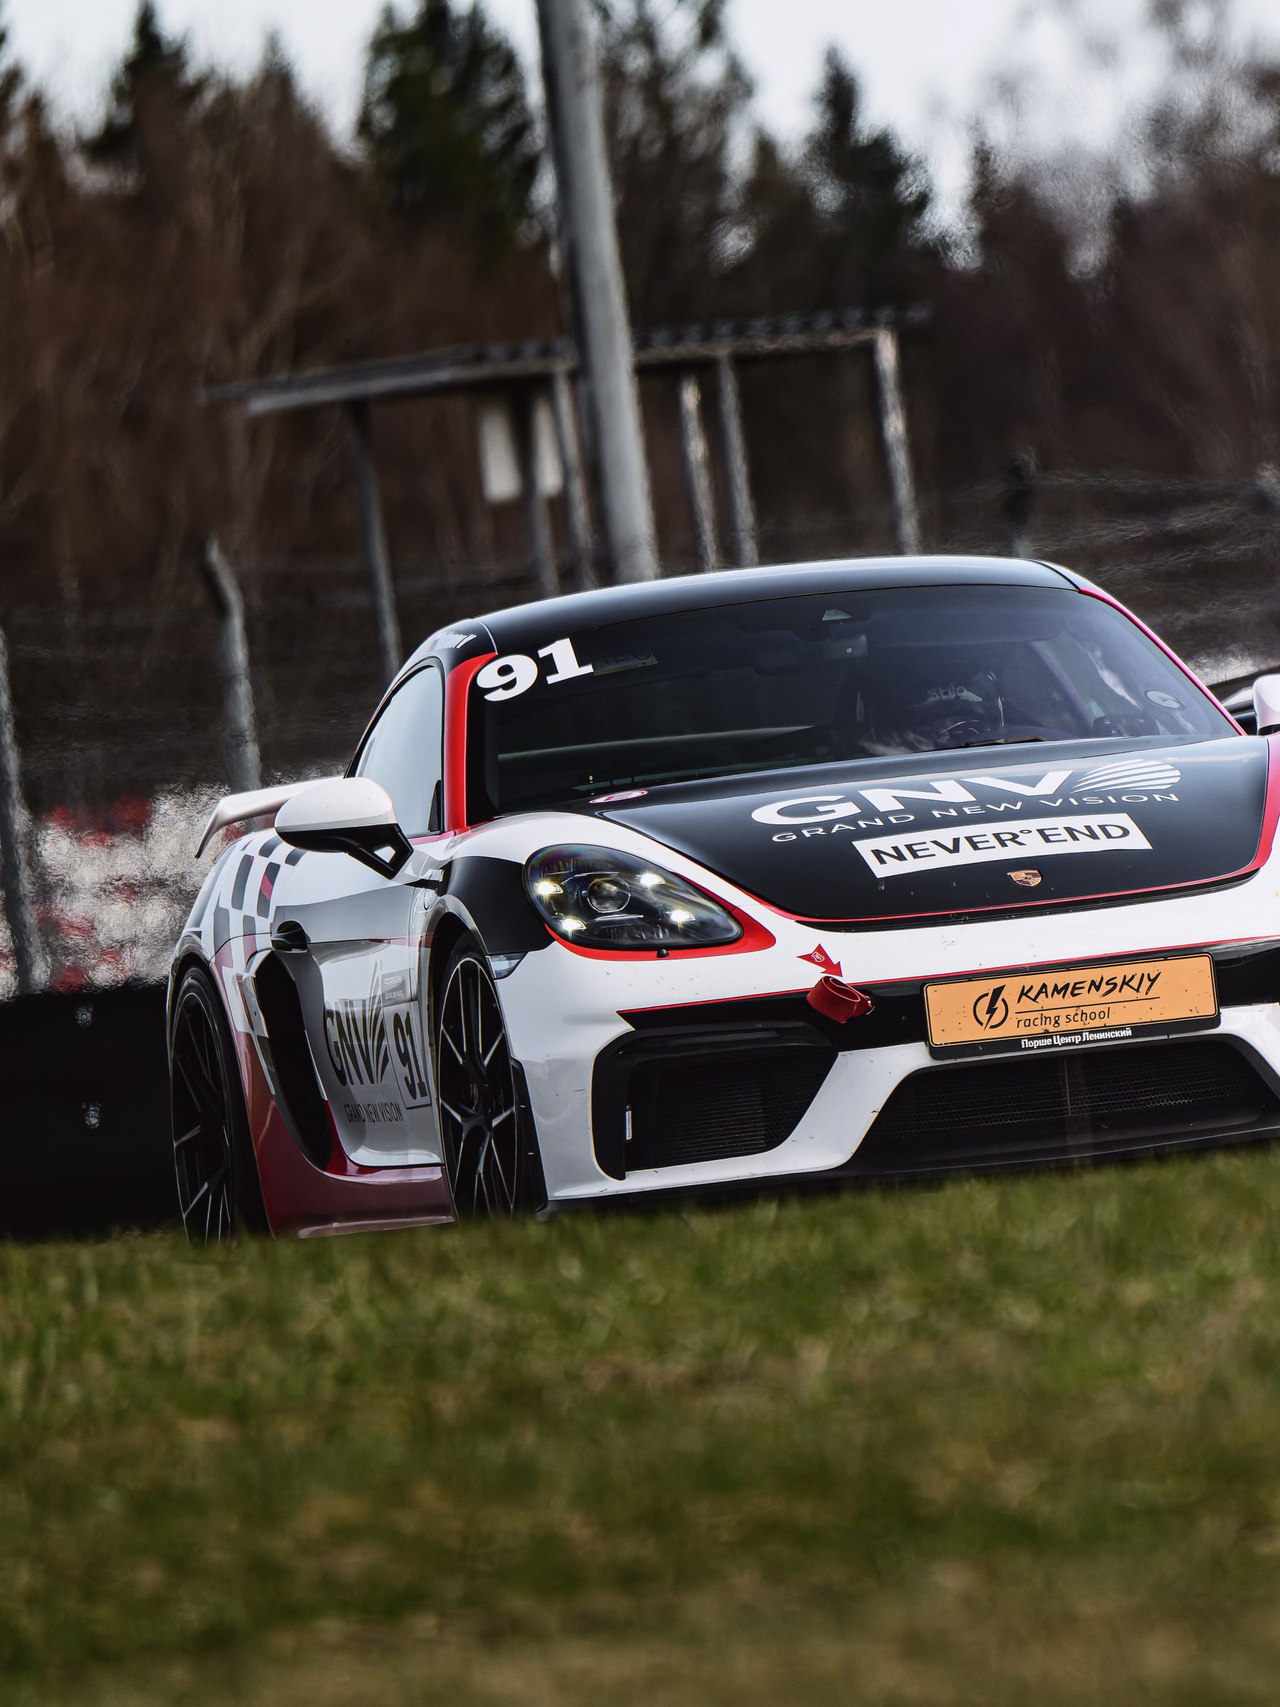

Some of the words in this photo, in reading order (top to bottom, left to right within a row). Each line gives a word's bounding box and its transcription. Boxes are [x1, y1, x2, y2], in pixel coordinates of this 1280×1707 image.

[476, 637, 594, 702] 91
[751, 770, 1074, 826] GNV
[772, 813, 916, 843] GRAND
[931, 800, 1024, 818] NEW
[1040, 793, 1180, 808] VISION
[1016, 971, 1162, 1005] KAMENSKIY
[1016, 1012, 1061, 1029] racing
[1065, 1007, 1111, 1025] school
[1021, 1038, 1052, 1049] Порше
[1053, 1034, 1081, 1046] Центр
[1082, 1027, 1132, 1041] Ленинский
[323, 1001, 375, 1087] GNV
[393, 1011, 428, 1100] 91
[362, 1103, 381, 1123] NEW
[377, 1101, 404, 1123] VISION
